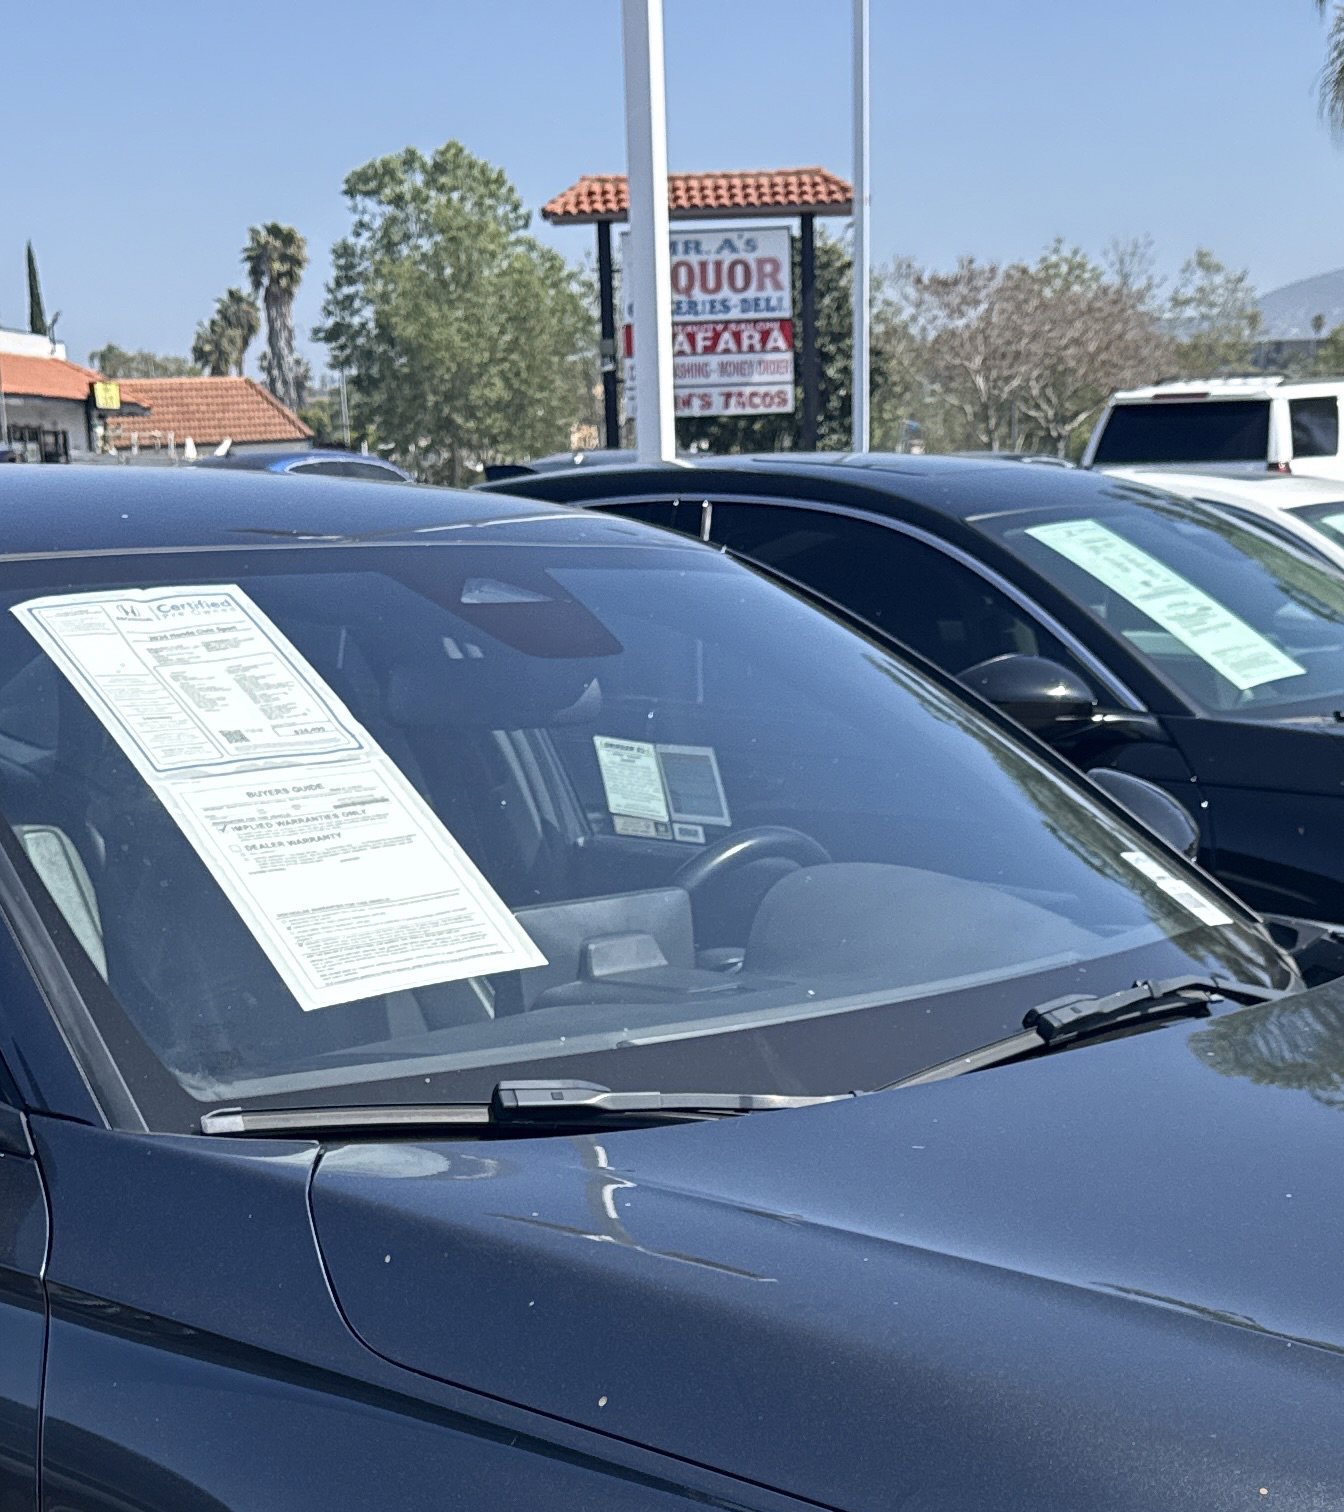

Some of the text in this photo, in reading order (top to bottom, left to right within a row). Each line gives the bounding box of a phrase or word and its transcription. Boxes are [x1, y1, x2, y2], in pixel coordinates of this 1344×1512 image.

[671, 257, 785, 300] QUOR
[674, 328, 788, 355] AFARA
[720, 389, 789, 410] TACOS
[156, 599, 232, 614] Certified
[245, 783, 326, 799] BUYERS GUIDE
[244, 832, 343, 852] DEALER WARRANTY
